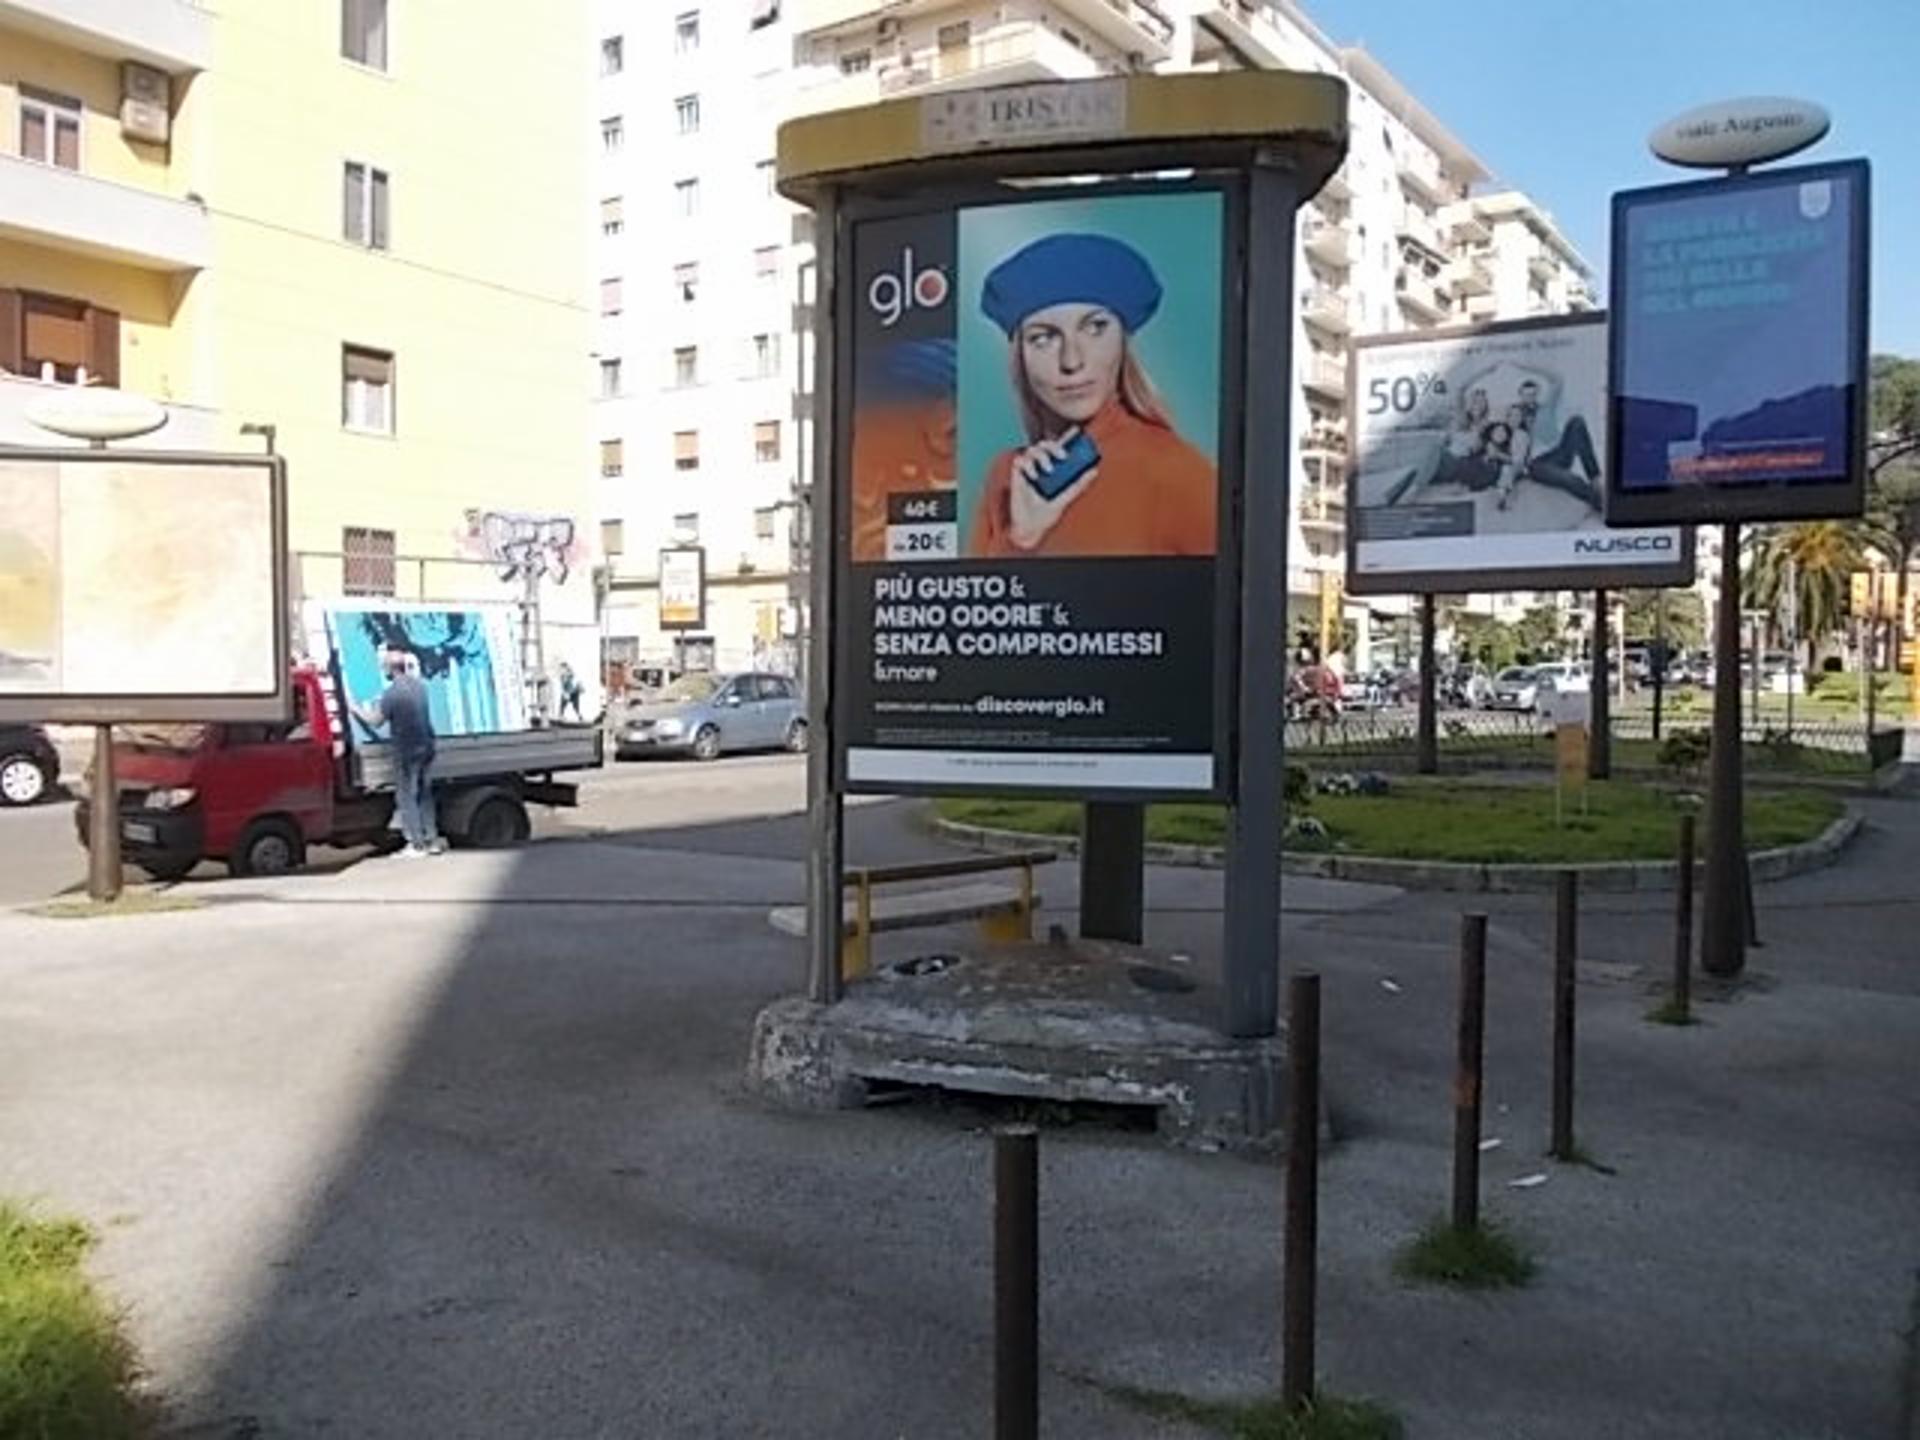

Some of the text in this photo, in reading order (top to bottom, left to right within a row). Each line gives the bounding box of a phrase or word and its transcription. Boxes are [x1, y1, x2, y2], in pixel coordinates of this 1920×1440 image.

[869, 246, 949, 327] glo
[1574, 536, 1672, 554] NUSCO
[874, 572, 1025, 600] PIÙ GUSTO &
[874, 605, 946, 627] MENO
[1052, 603, 1070, 626] &
[874, 632, 1163, 656] SENZA COMPROMESSI
[976, 695, 1104, 718] discoverglo.it
